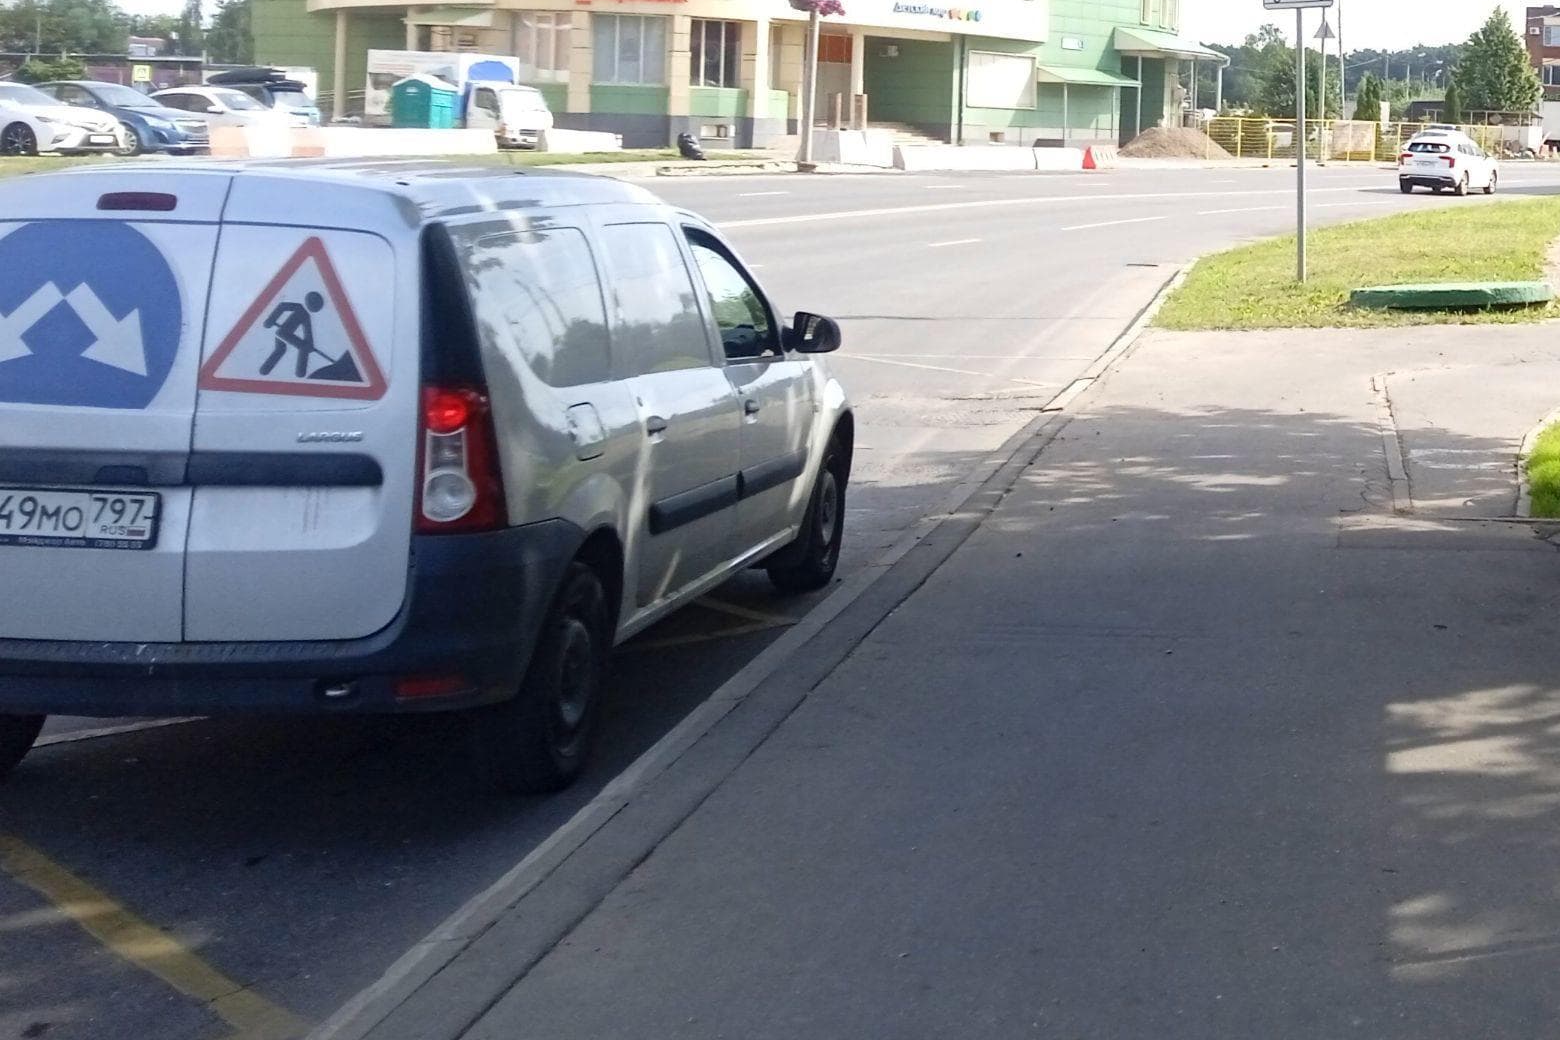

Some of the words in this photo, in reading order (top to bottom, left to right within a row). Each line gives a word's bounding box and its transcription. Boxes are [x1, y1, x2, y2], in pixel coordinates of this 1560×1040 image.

[296, 431, 363, 443] LARGUS
[93, 497, 145, 525] 797
[100, 524, 127, 536] RUS
